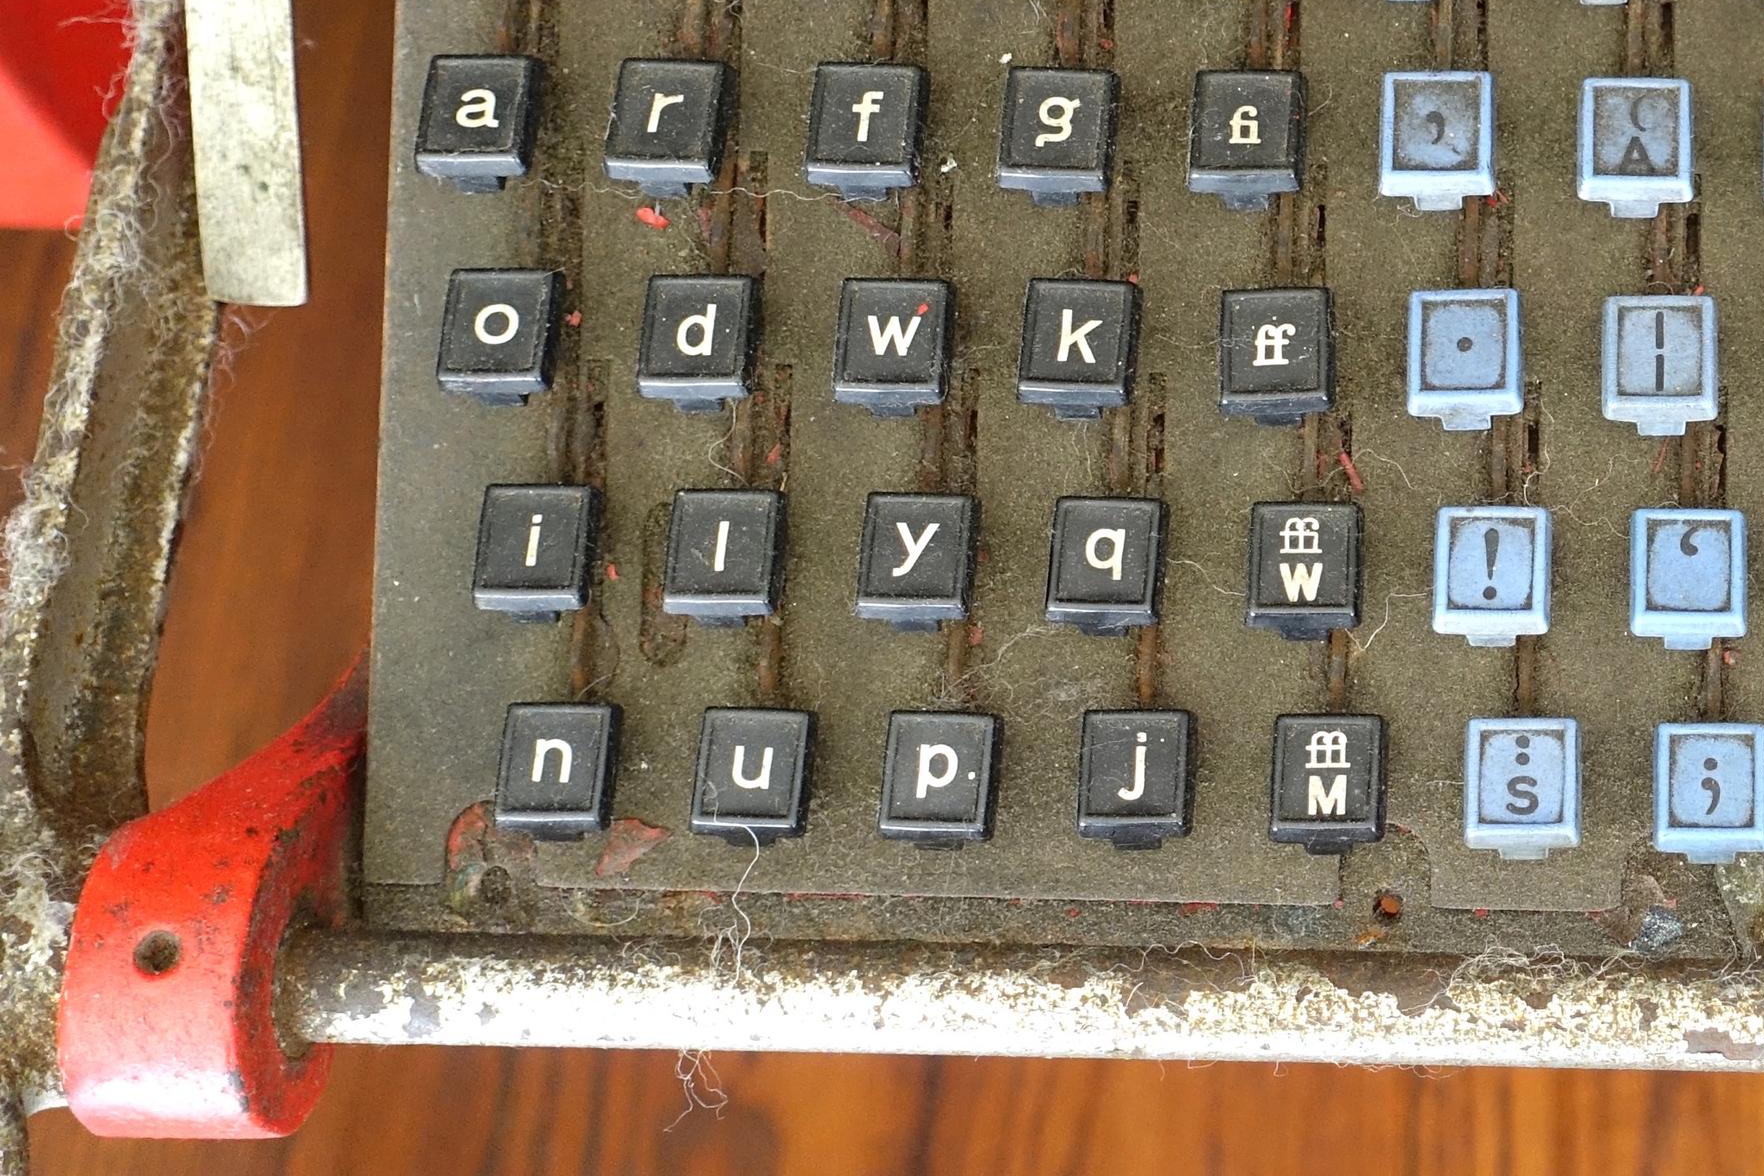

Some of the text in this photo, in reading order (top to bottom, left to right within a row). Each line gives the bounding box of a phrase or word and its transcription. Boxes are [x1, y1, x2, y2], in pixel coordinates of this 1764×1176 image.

[456, 89, 498, 129] a
[647, 93, 684, 133] r
[852, 91, 884, 141] f
[1035, 96, 1080, 148] g
[1629, 95, 1647, 132] (
[1619, 136, 1656, 175] A
[474, 303, 519, 344] o
[676, 304, 717, 357] d
[868, 315, 918, 357] w
[1057, 309, 1103, 364] k
[525, 514, 542, 566] i
[892, 522, 940, 577] y
[1085, 528, 1126, 581] q
[1483, 528, 1499, 600] !
[1280, 563, 1322, 602] W
[532, 737, 572, 783] n
[731, 745, 773, 790] u
[916, 743, 958, 798] p
[1117, 732, 1147, 801] j
[1308, 774, 1347, 815] M
[1507, 776, 1539, 816] S
[1700, 757, 1720, 816] ;
